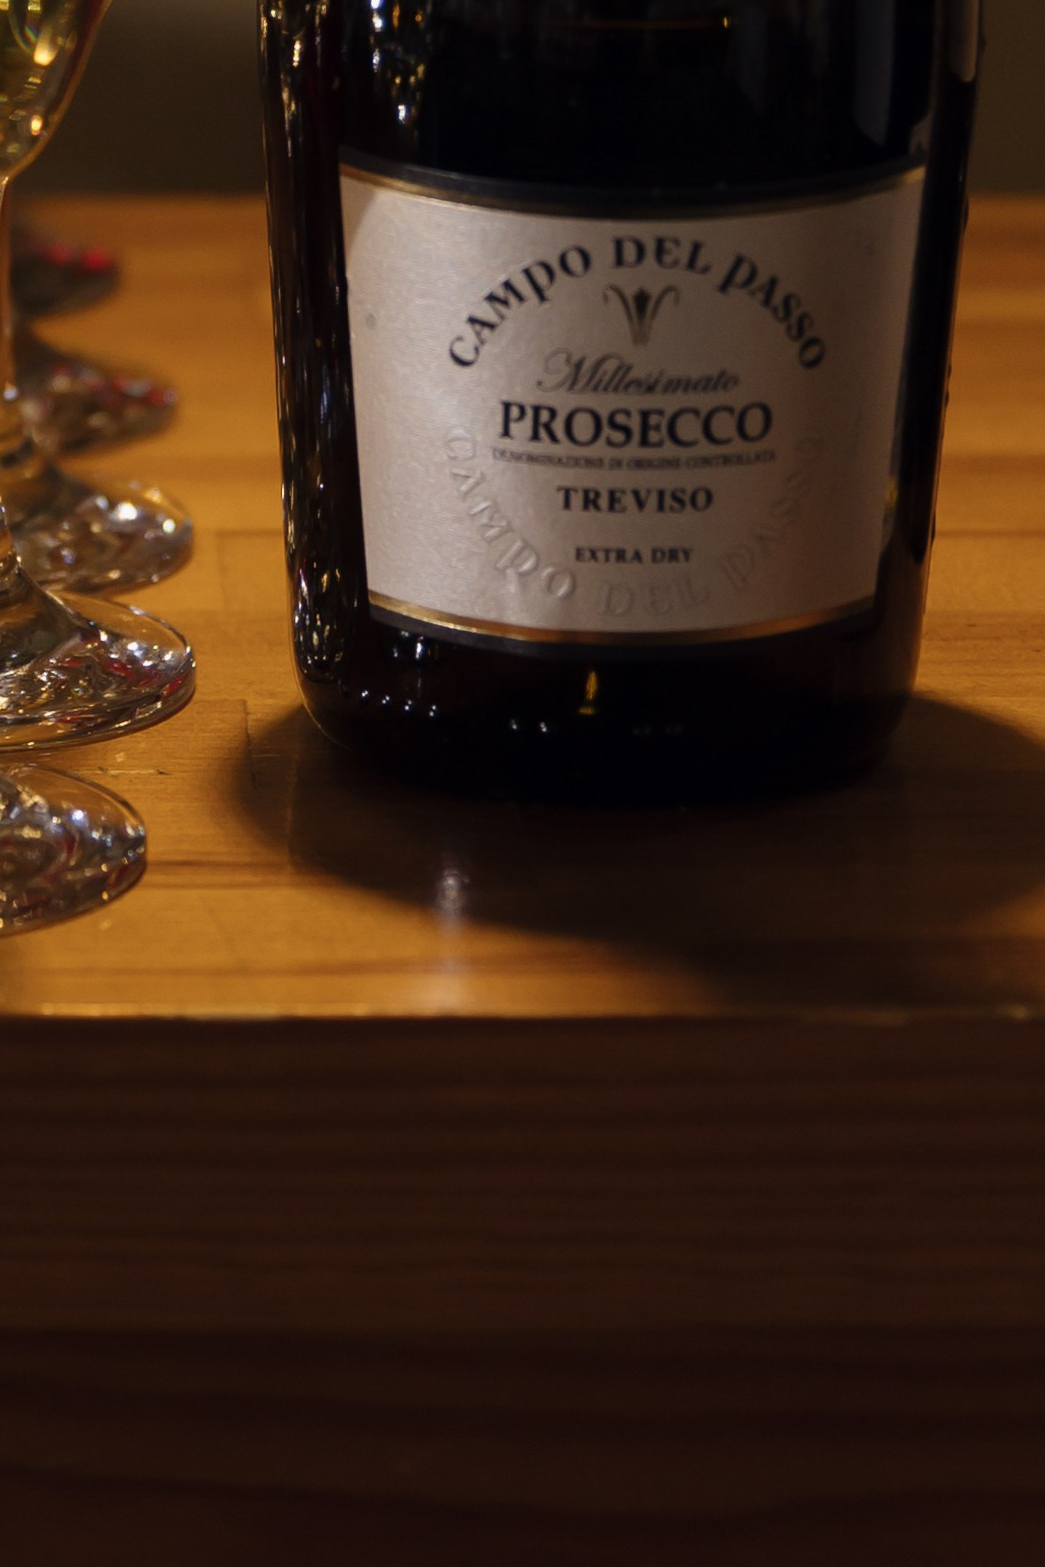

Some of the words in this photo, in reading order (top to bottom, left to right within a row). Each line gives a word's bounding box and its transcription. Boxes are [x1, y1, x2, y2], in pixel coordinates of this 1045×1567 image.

[449, 245, 591, 368] CAMPO
[611, 237, 711, 275] DEL
[718, 253, 826, 371] PASSO
[536, 347, 739, 394] Millesimato
[499, 400, 773, 448] PROSECCO
[491, 447, 605, 469] DENOMINAZIONE
[684, 449, 776, 470] CONTROLLATA
[444, 427, 577, 600] CAMPO
[557, 486, 713, 513] TREVISO
[575, 547, 643, 564] EXTRA
[650, 547, 693, 564] DRY
